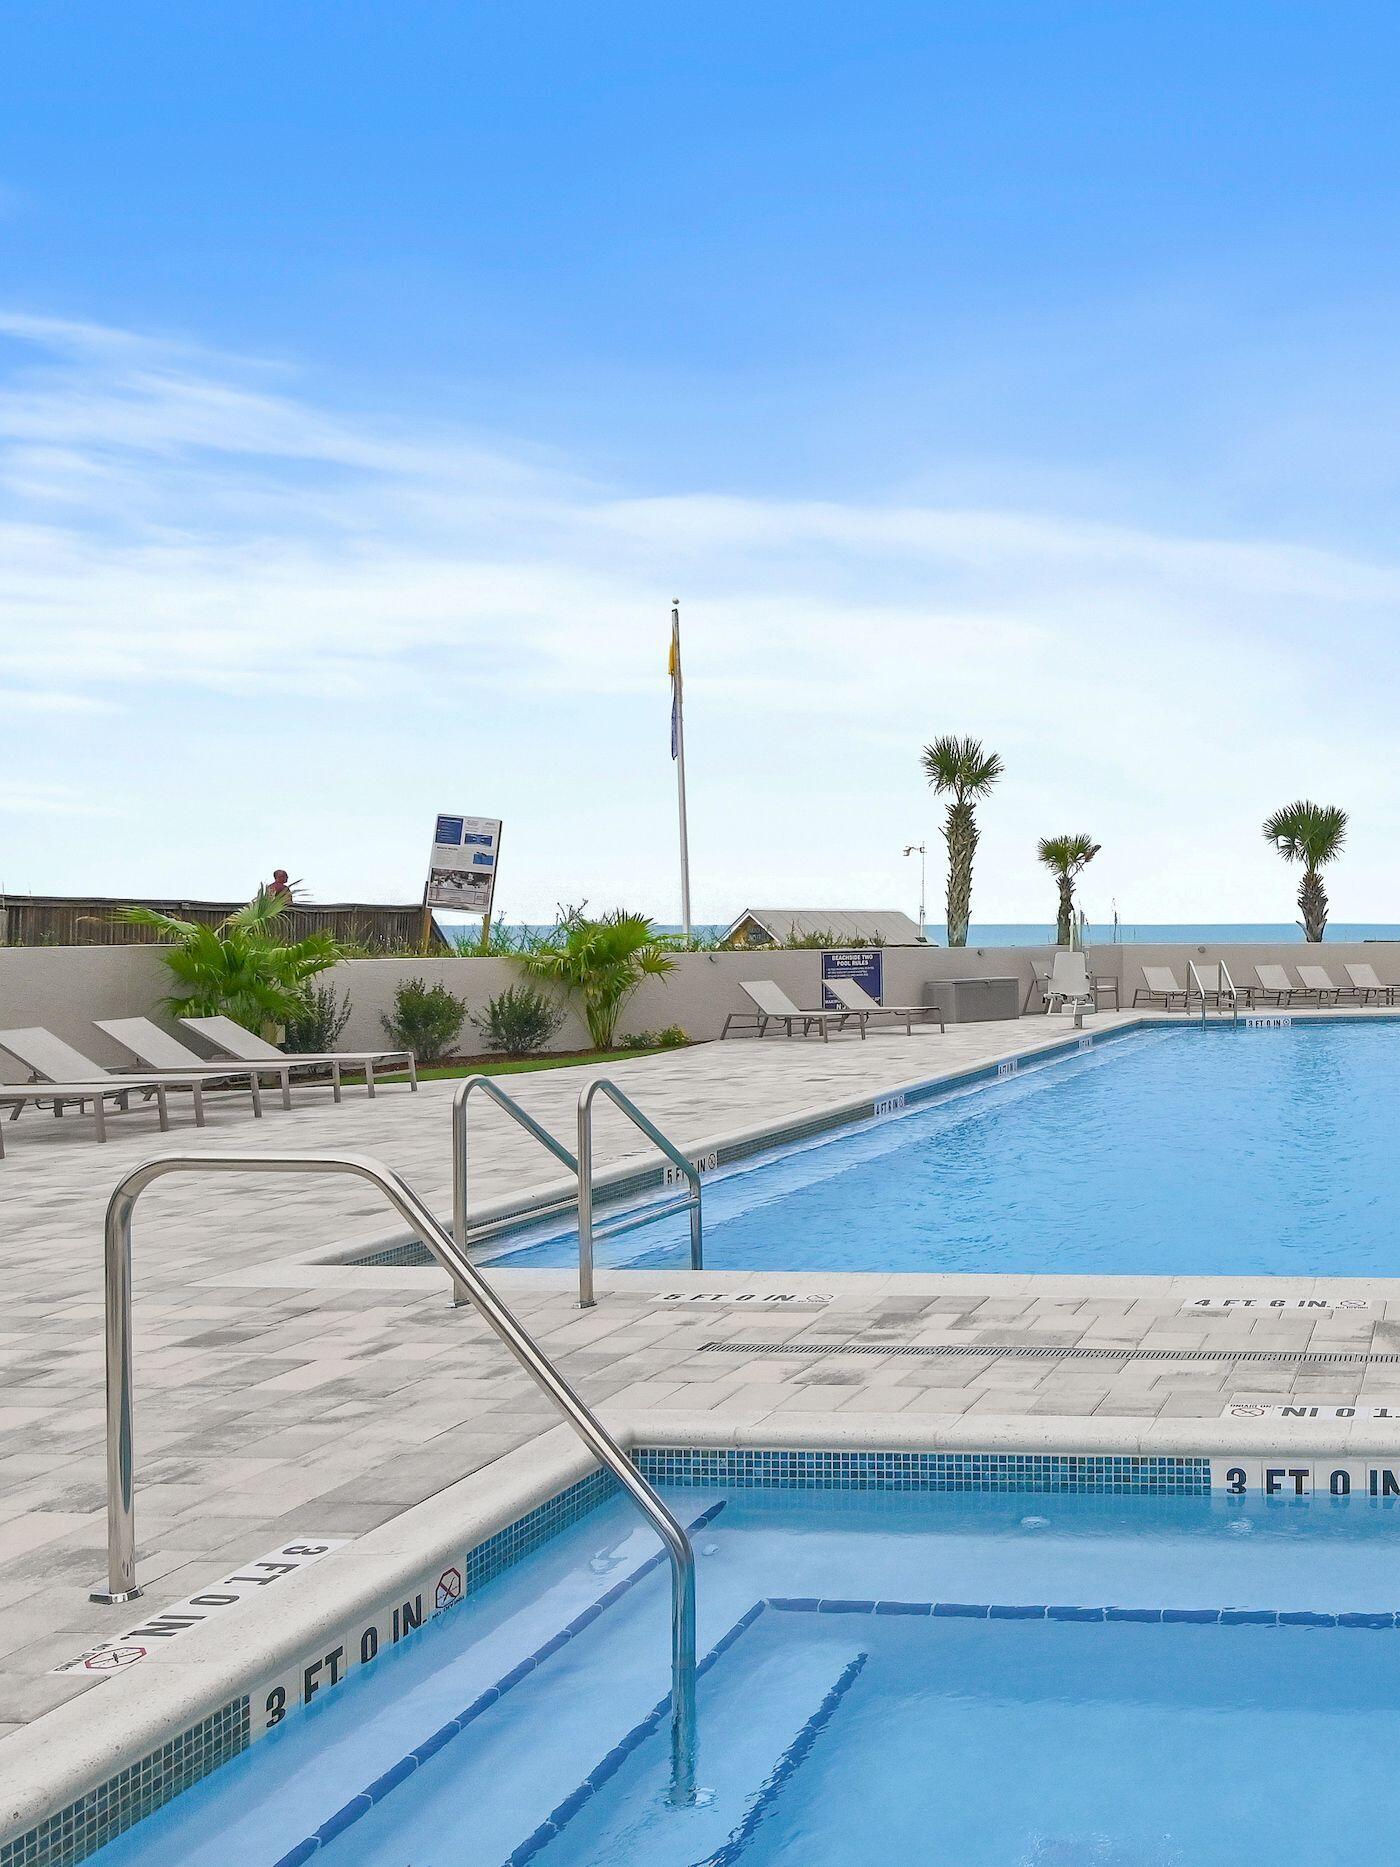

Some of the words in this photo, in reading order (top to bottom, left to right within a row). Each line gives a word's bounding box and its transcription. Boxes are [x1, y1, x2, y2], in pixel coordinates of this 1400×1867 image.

[663, 1293, 686, 1301] 5
[1194, 1299, 1211, 1307] 4
[1335, 1407, 1356, 1418] 0
[1226, 1467, 1247, 1496] 3
[1265, 1468, 1311, 1496] FT.
[1329, 1469, 1351, 1496] 0
[281, 1544, 329, 1556] 3
[223, 1561, 302, 1586] FT.
[188, 1593, 241, 1606] 0
[119, 1614, 208, 1641] IN.
[265, 1685, 287, 1728] 3
[304, 1645, 345, 1705] FT.
[360, 1626, 379, 1665] 0
[392, 1593, 428, 1644] IN.
